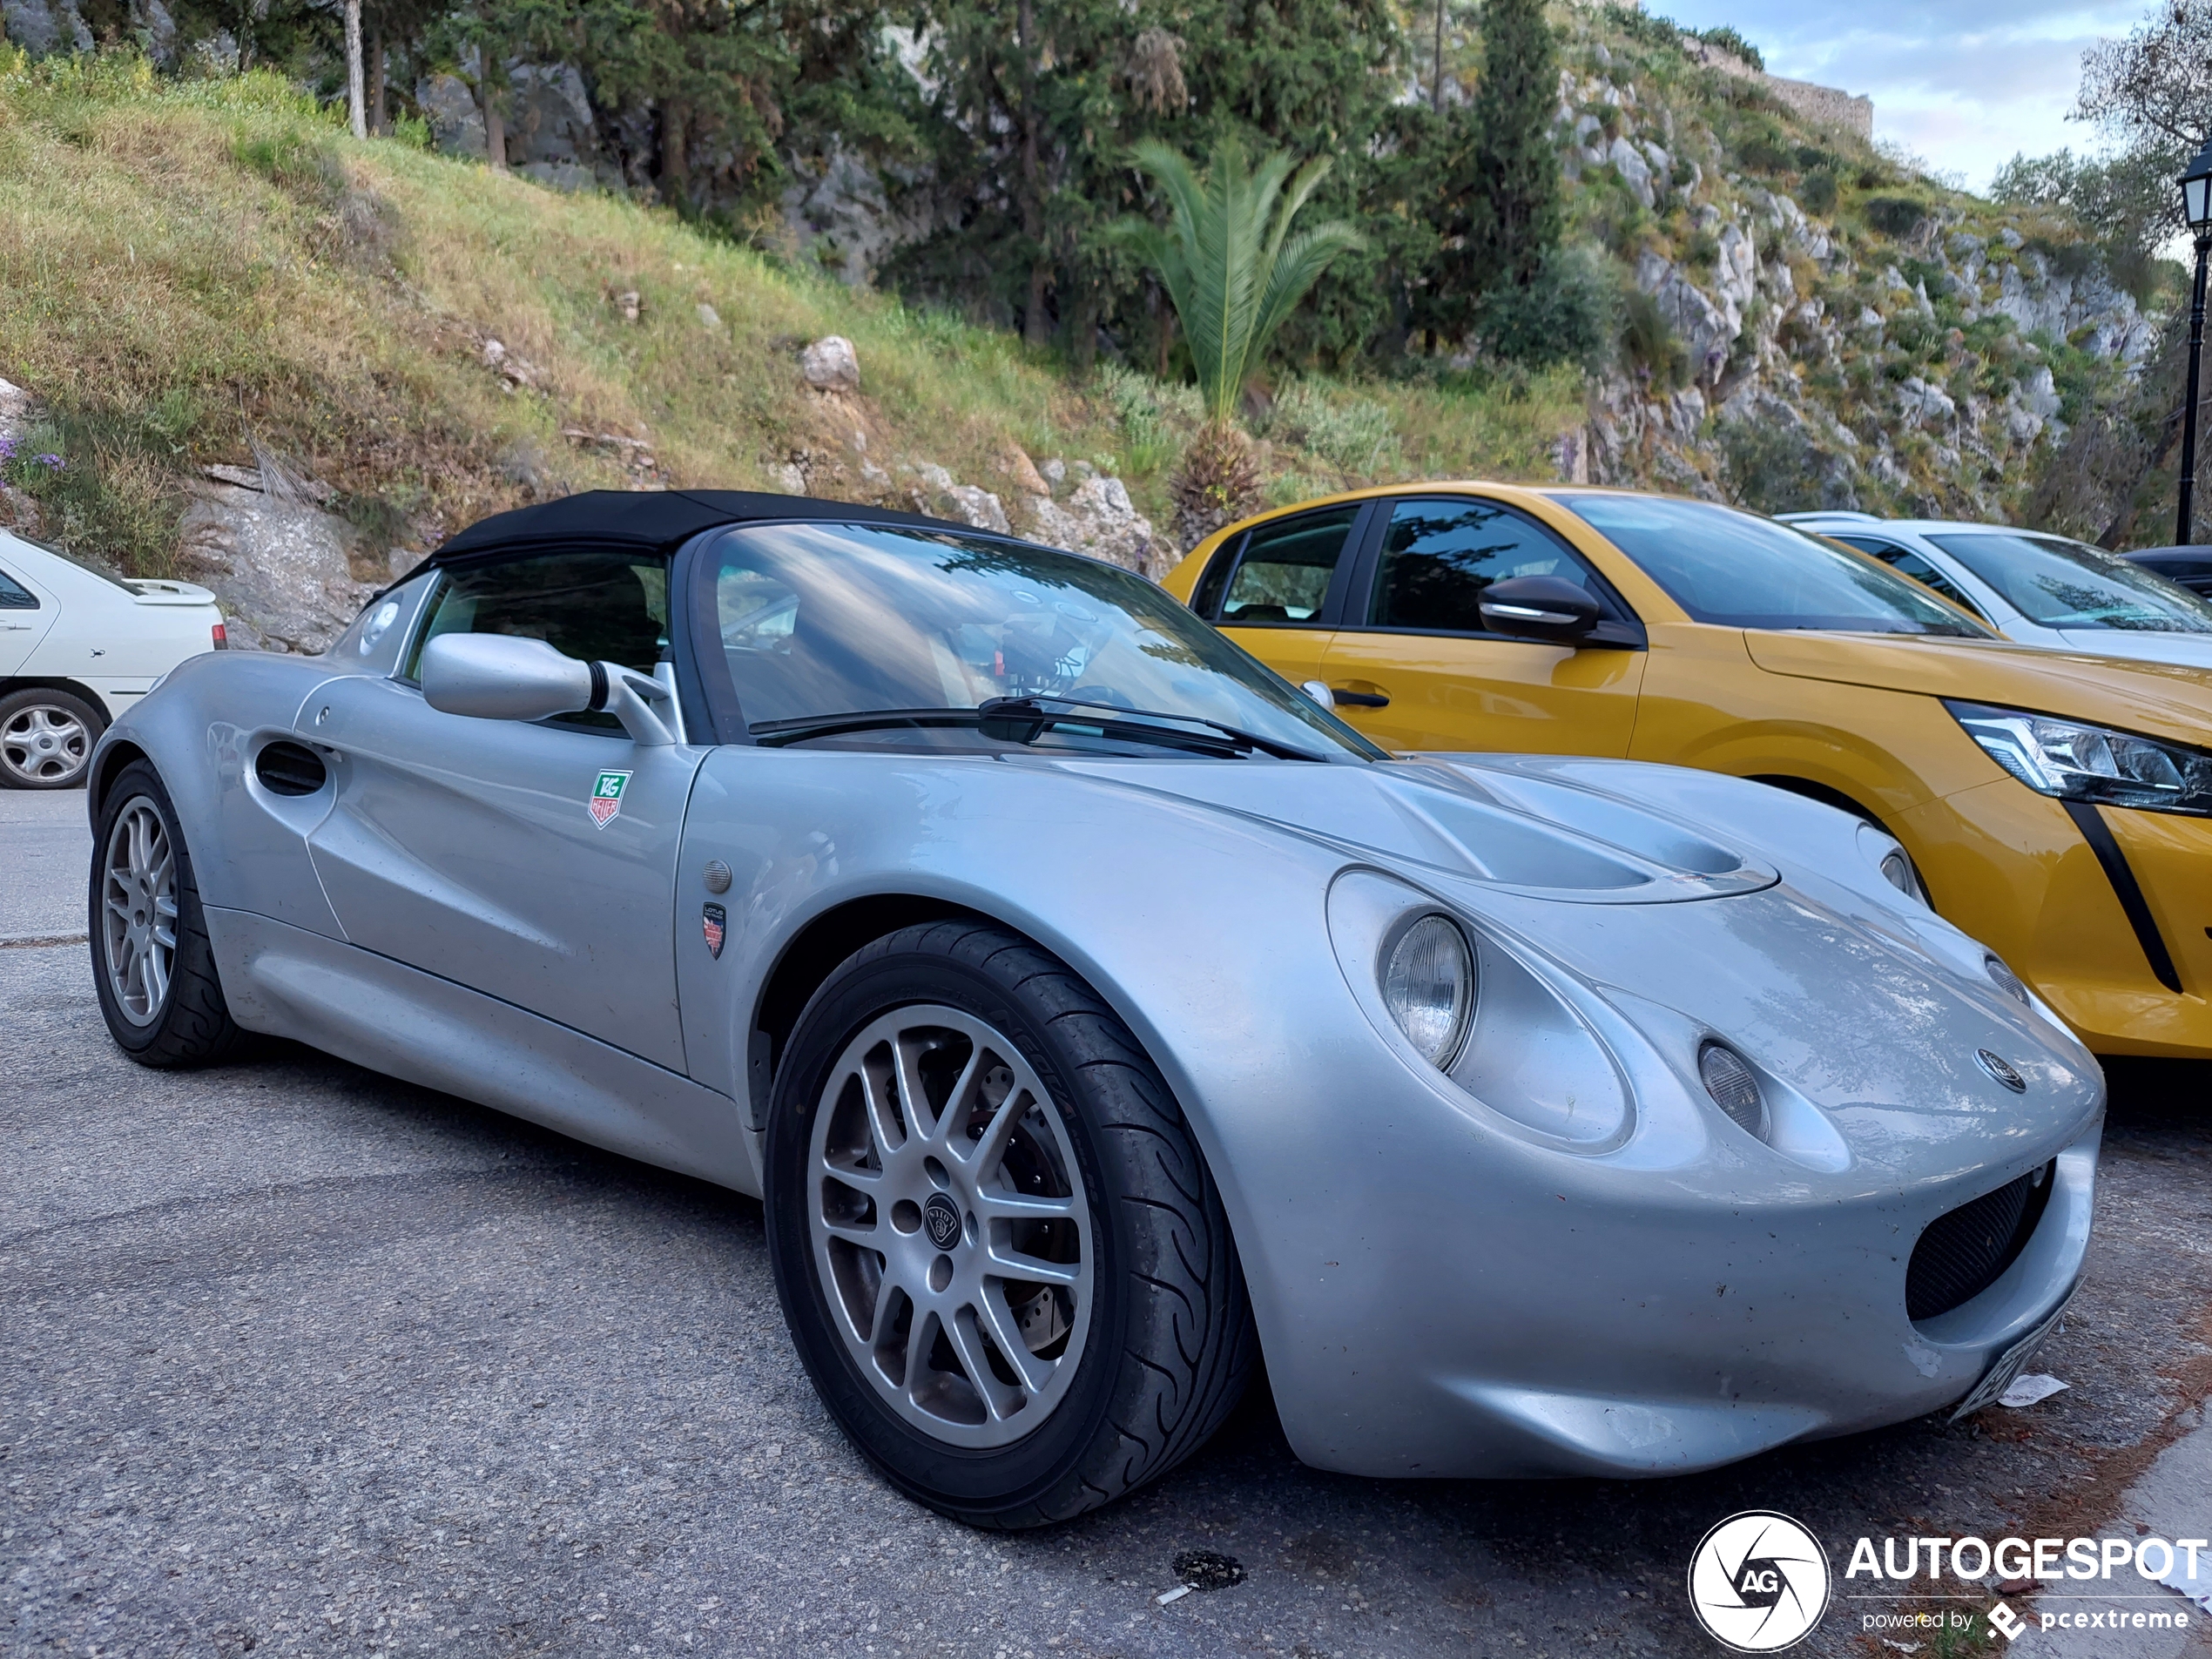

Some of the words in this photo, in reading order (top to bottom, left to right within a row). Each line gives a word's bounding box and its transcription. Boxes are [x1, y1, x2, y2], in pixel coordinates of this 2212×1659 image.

[599, 777, 619, 797] TAG
[592, 799, 617, 820] HEUER
[705, 907, 724, 916] LOTUS
[988, 1008, 1077, 1121] NEOVA
[928, 1210, 954, 1228] LOTUS
